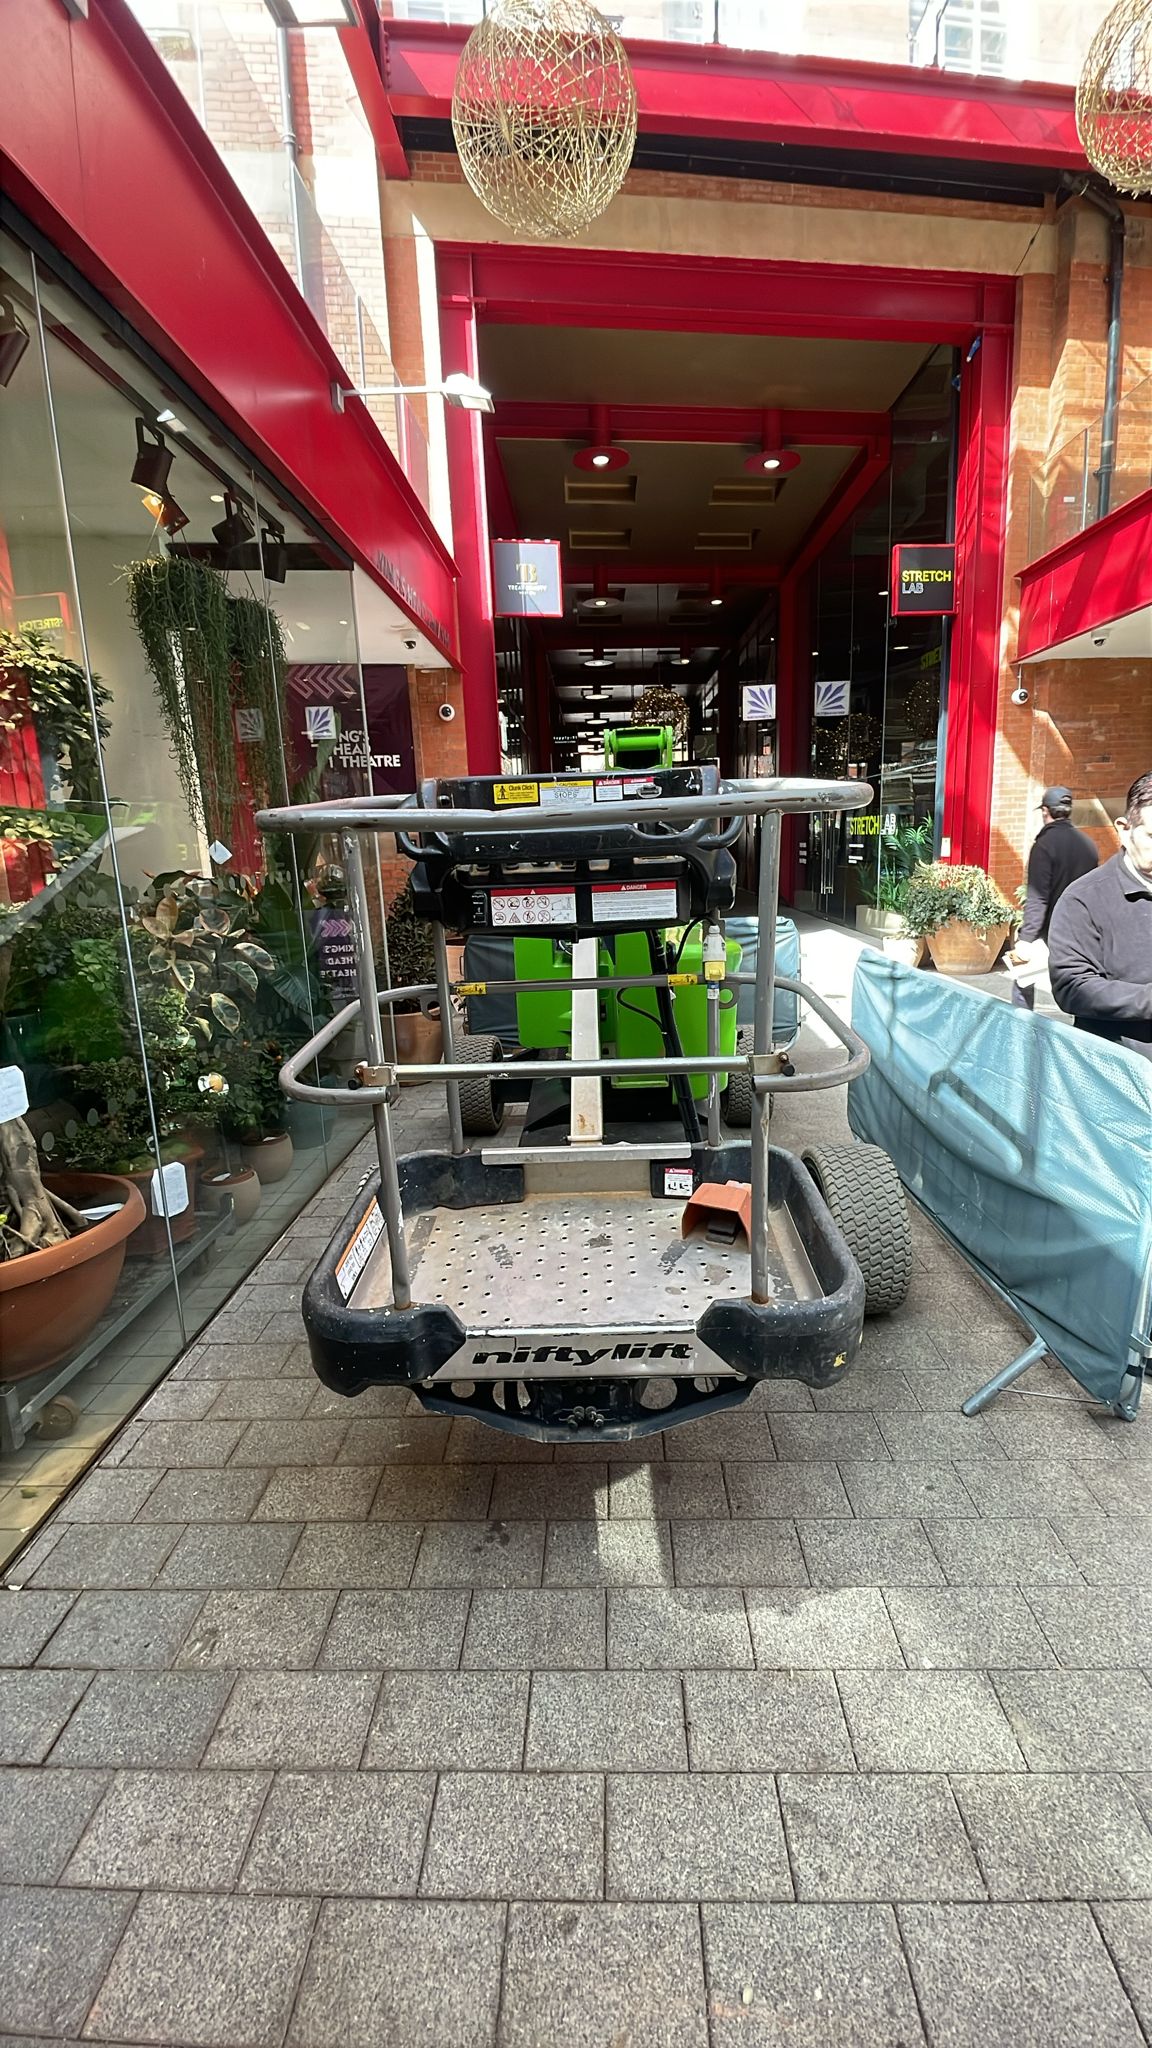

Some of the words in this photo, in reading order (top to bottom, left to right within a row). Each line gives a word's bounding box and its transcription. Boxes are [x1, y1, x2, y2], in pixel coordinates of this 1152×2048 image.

[901, 570, 951, 582] STRETCH
[902, 582, 923, 594] LAB
[333, 743, 371, 756] HEAD
[339, 754, 401, 768] THEATRE
[849, 815, 879, 835] STRETCH
[879, 813, 896, 835] LAB
[471, 1342, 693, 1367] niftylift
